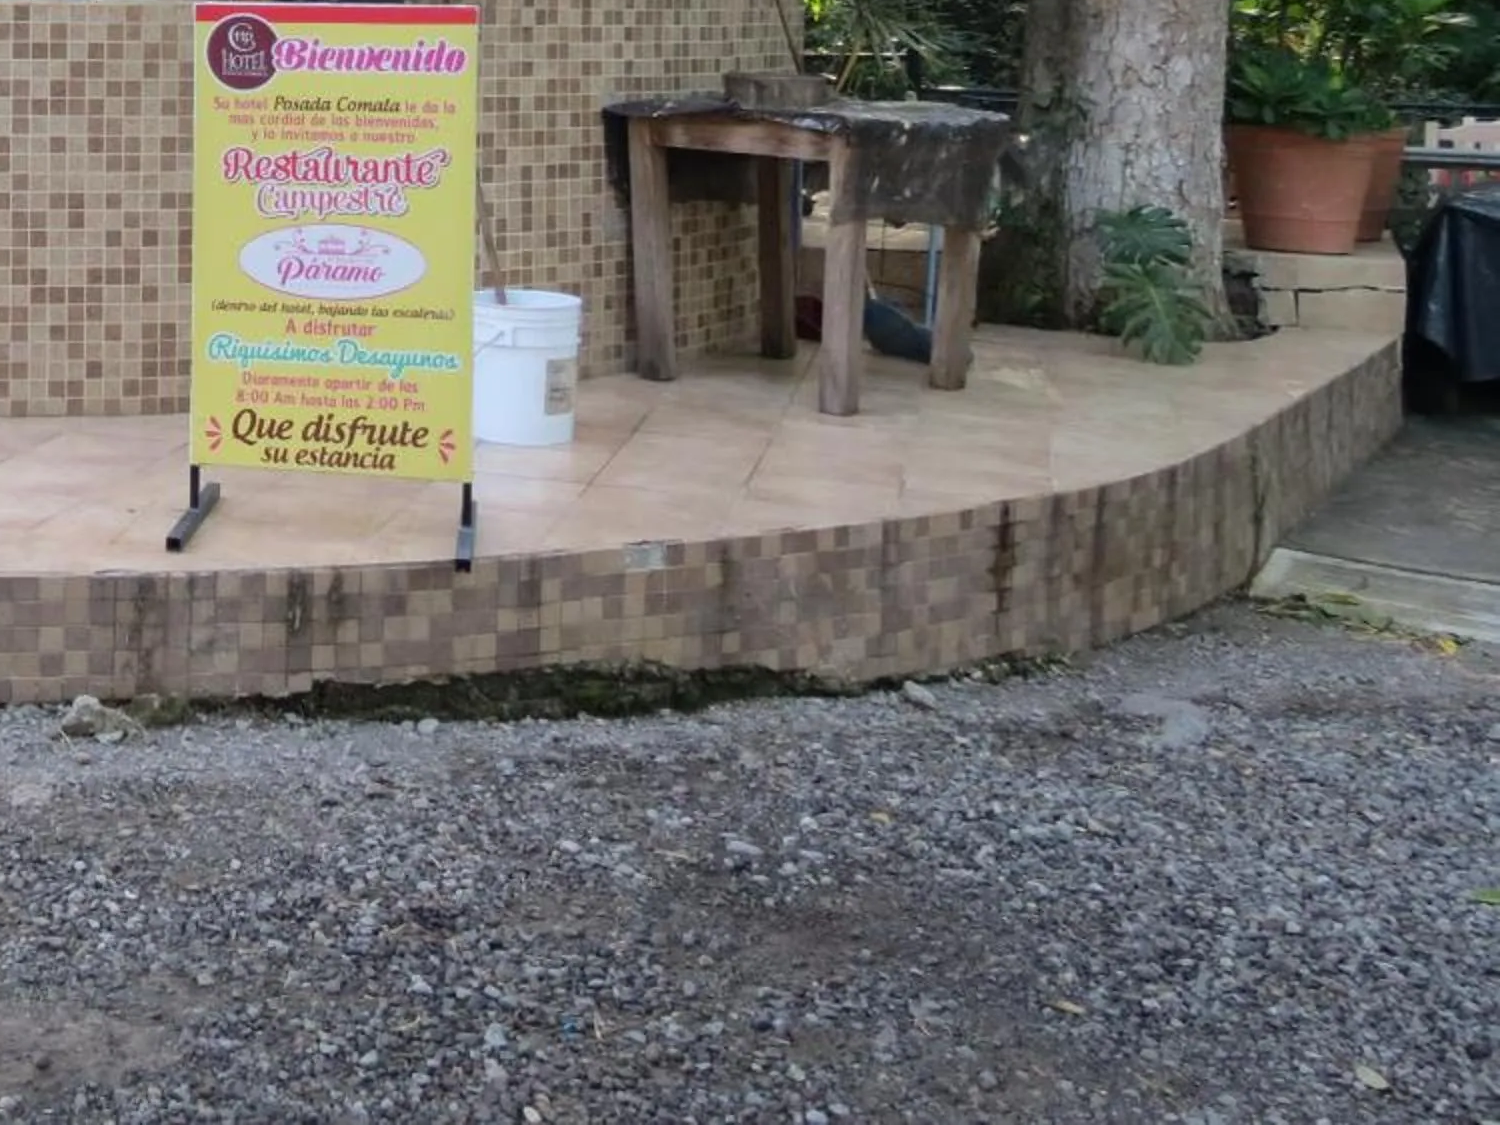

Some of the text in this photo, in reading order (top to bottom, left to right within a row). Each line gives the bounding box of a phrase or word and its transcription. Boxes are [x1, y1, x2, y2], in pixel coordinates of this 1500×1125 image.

[221, 48, 266, 76] HOTEL
[272, 37, 467, 73] Bienvenido
[213, 96, 230, 110] Su
[234, 96, 268, 110] hotel
[273, 95, 333, 111] Posada
[336, 97, 401, 111] Comala
[405, 100, 417, 112] le
[260, 114, 305, 126] cordial
[311, 114, 326, 126] de
[331, 114, 349, 126] las
[251, 130, 258, 142] y
[281, 127, 344, 141] invitamos
[362, 132, 415, 144] nuestro
[223, 146, 447, 184] Restaurante
[257, 184, 404, 216] Campestre
[277, 256, 385, 285] Páramo
[318, 304, 369, 317] bajando
[371, 306, 389, 317] las
[285, 318, 377, 337] A disfrutar
[336, 338, 460, 379] Desayunos
[324, 378, 371, 392] apartir
[378, 379, 395, 392] de
[399, 380, 418, 393] las
[235, 389, 426, 412] 8:00 Am hasta las 2:00 Pm
[231, 408, 430, 448] Que disfrute
[260, 445, 396, 470] su estancia
